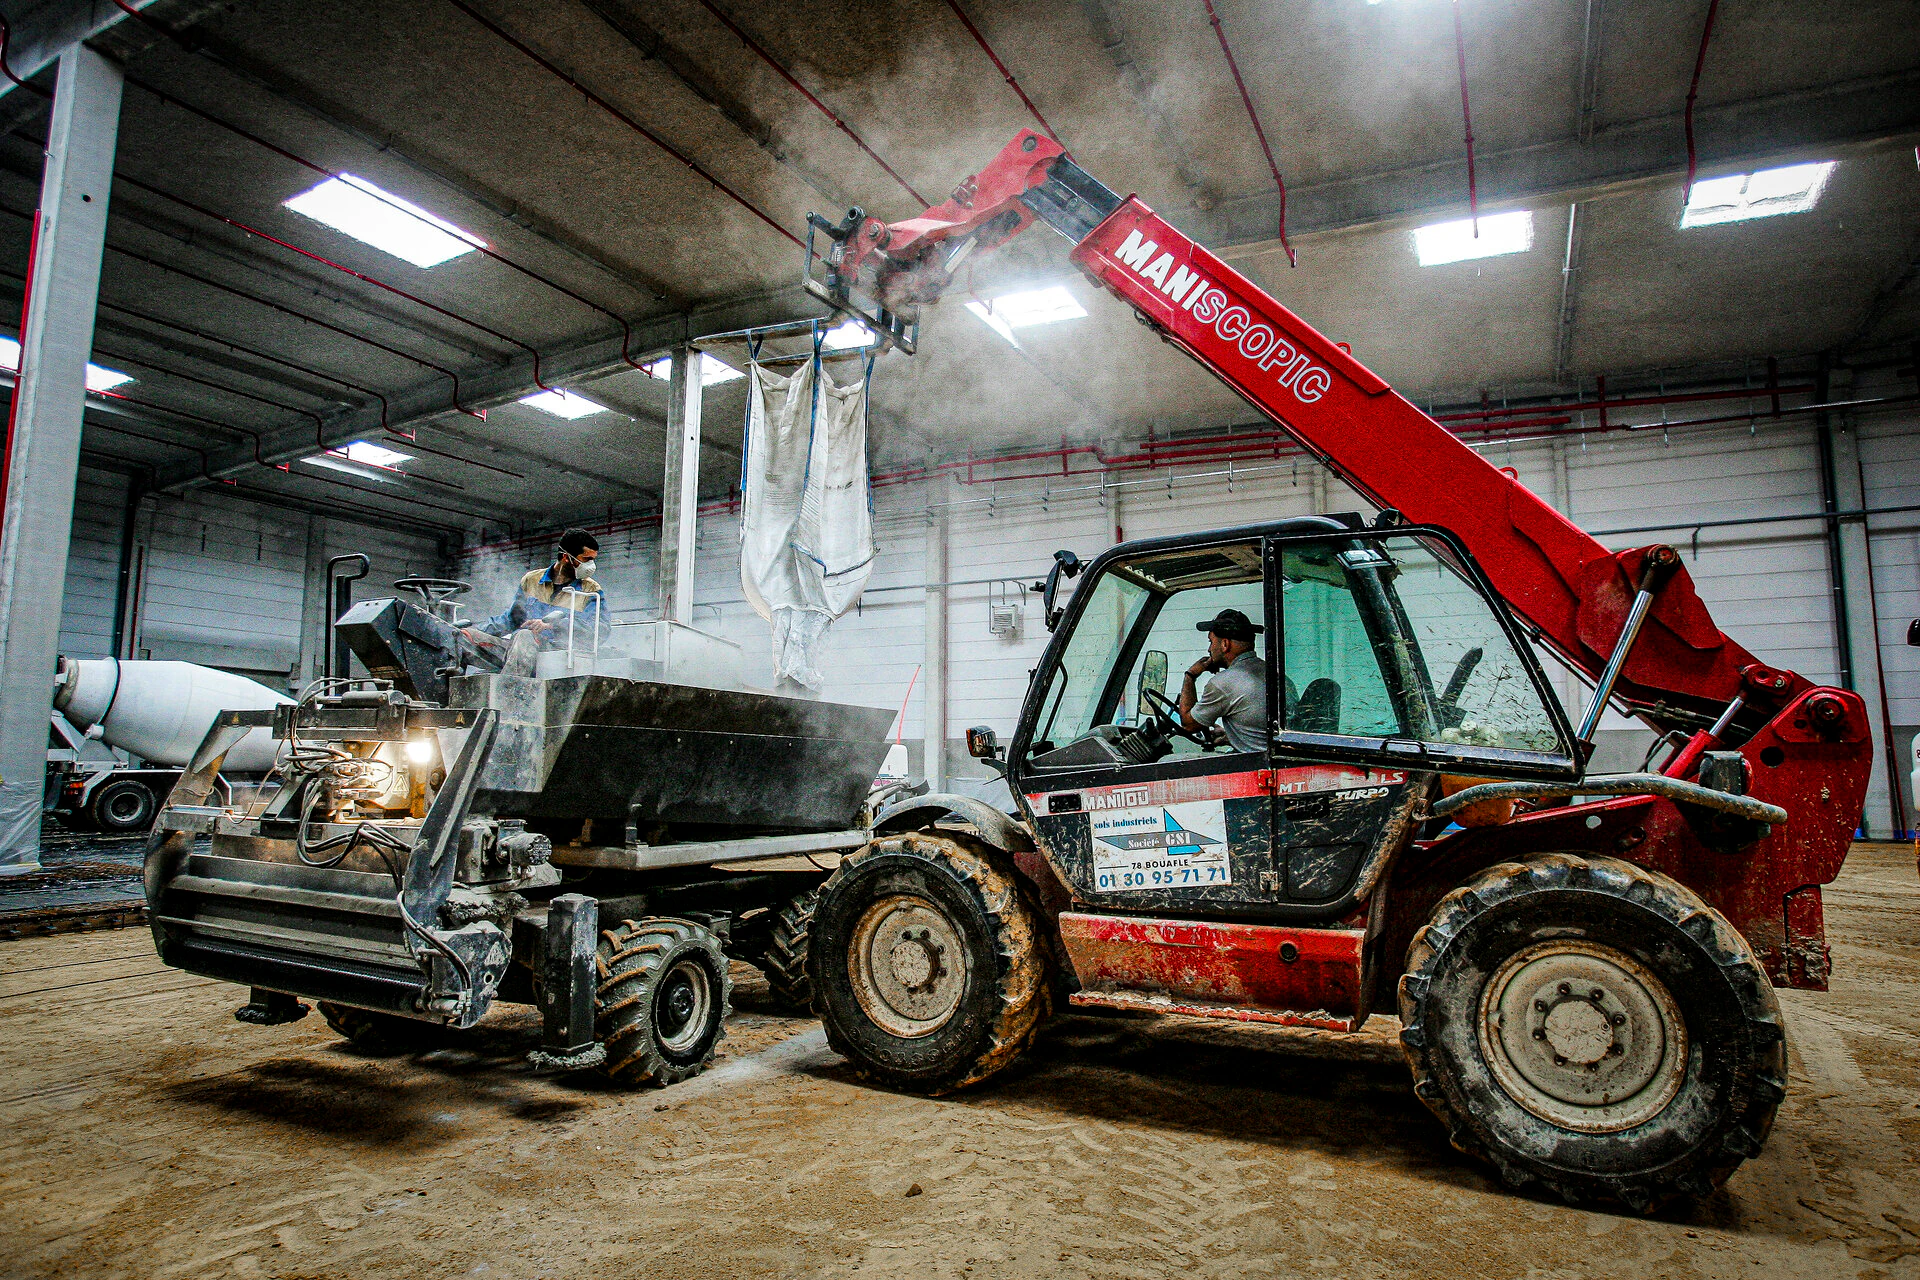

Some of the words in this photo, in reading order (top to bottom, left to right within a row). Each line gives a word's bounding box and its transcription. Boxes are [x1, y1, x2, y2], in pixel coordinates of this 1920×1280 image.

[1114, 228, 1332, 403] MANISCOPIC
[1381, 772, 1404, 784] LS
[1082, 786, 1149, 811] MANITOU
[1335, 787, 1389, 802] TURBO
[1093, 820, 1110, 829] sols
[1112, 816, 1158, 828] industriels
[1128, 838, 1160, 849] Société
[1165, 832, 1191, 845] GSI
[1145, 858, 1189, 869] BOUAFLE
[1099, 874, 1116, 888] 01
[1123, 872, 1145, 887] 30
[1152, 870, 1173, 884] 95
[1180, 868, 1199, 883] 71
[1207, 867, 1226, 881] 71
